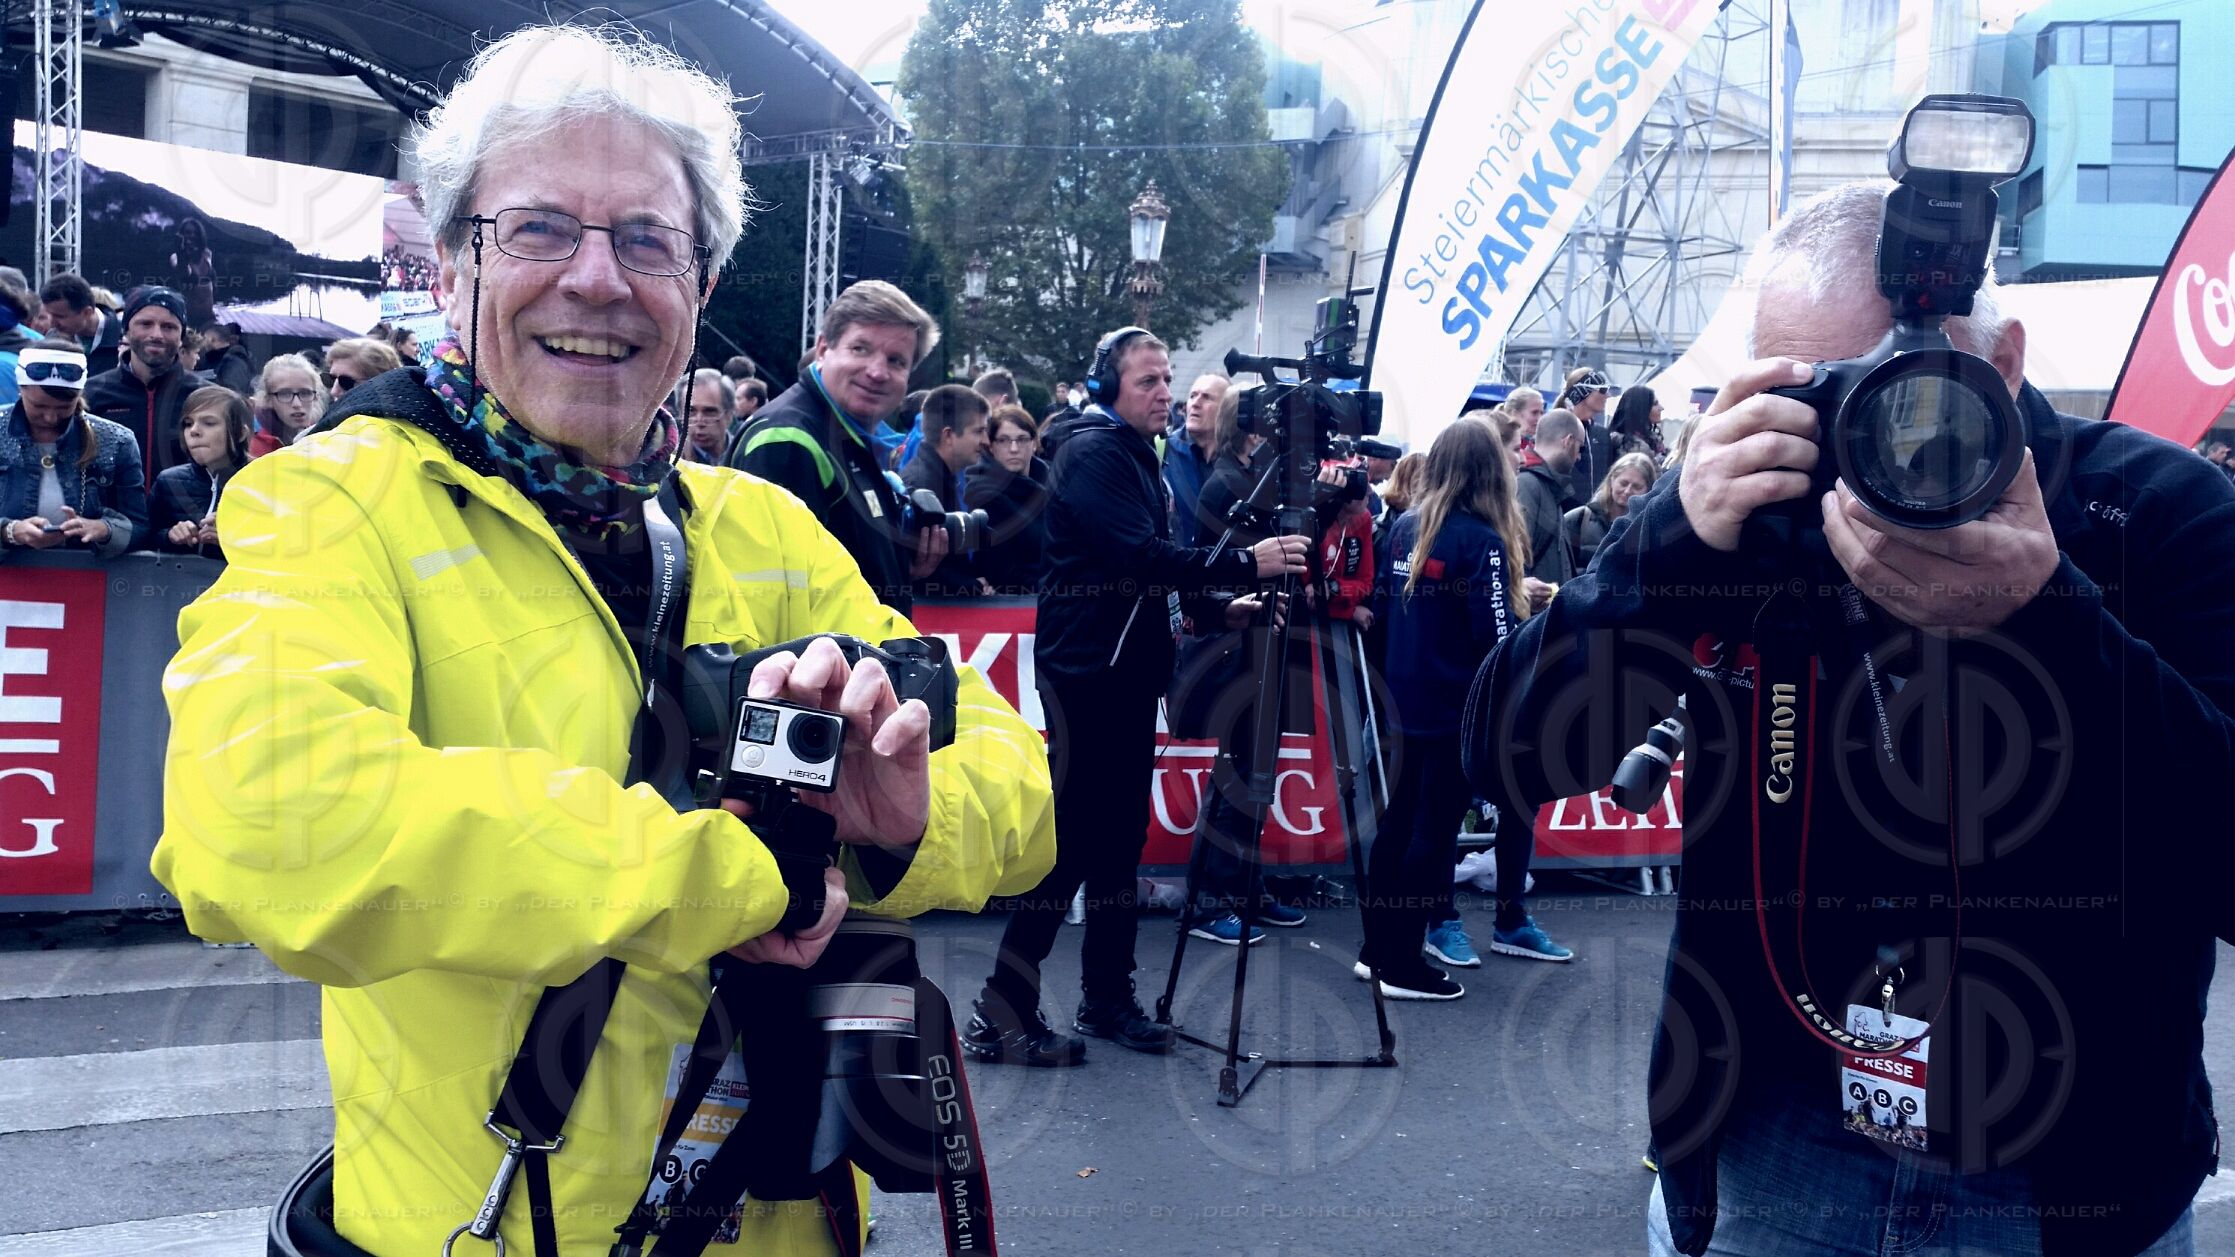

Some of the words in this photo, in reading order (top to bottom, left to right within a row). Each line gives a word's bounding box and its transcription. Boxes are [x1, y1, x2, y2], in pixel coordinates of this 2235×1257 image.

[1442, 13, 1664, 350] SPARKASSE
[1928, 199, 1963, 209] Canon
[1489, 550, 1508, 643] arathon.at
[1863, 652, 1895, 763] www.kleinezeitung.at
[1766, 684, 1796, 804] Canon
[789, 769, 826, 782] HERO4
[928, 1054, 962, 1126] EOS
[1853, 1086, 1863, 1098] A
[1879, 1092, 1888, 1105] B
[1903, 1099, 1913, 1112] C
[686, 1113, 738, 1135] RESS
[665, 1160, 677, 1178] B
[943, 1134, 972, 1173] 5D
[952, 1179, 973, 1229] Mark
[958, 1233, 974, 1251] III
